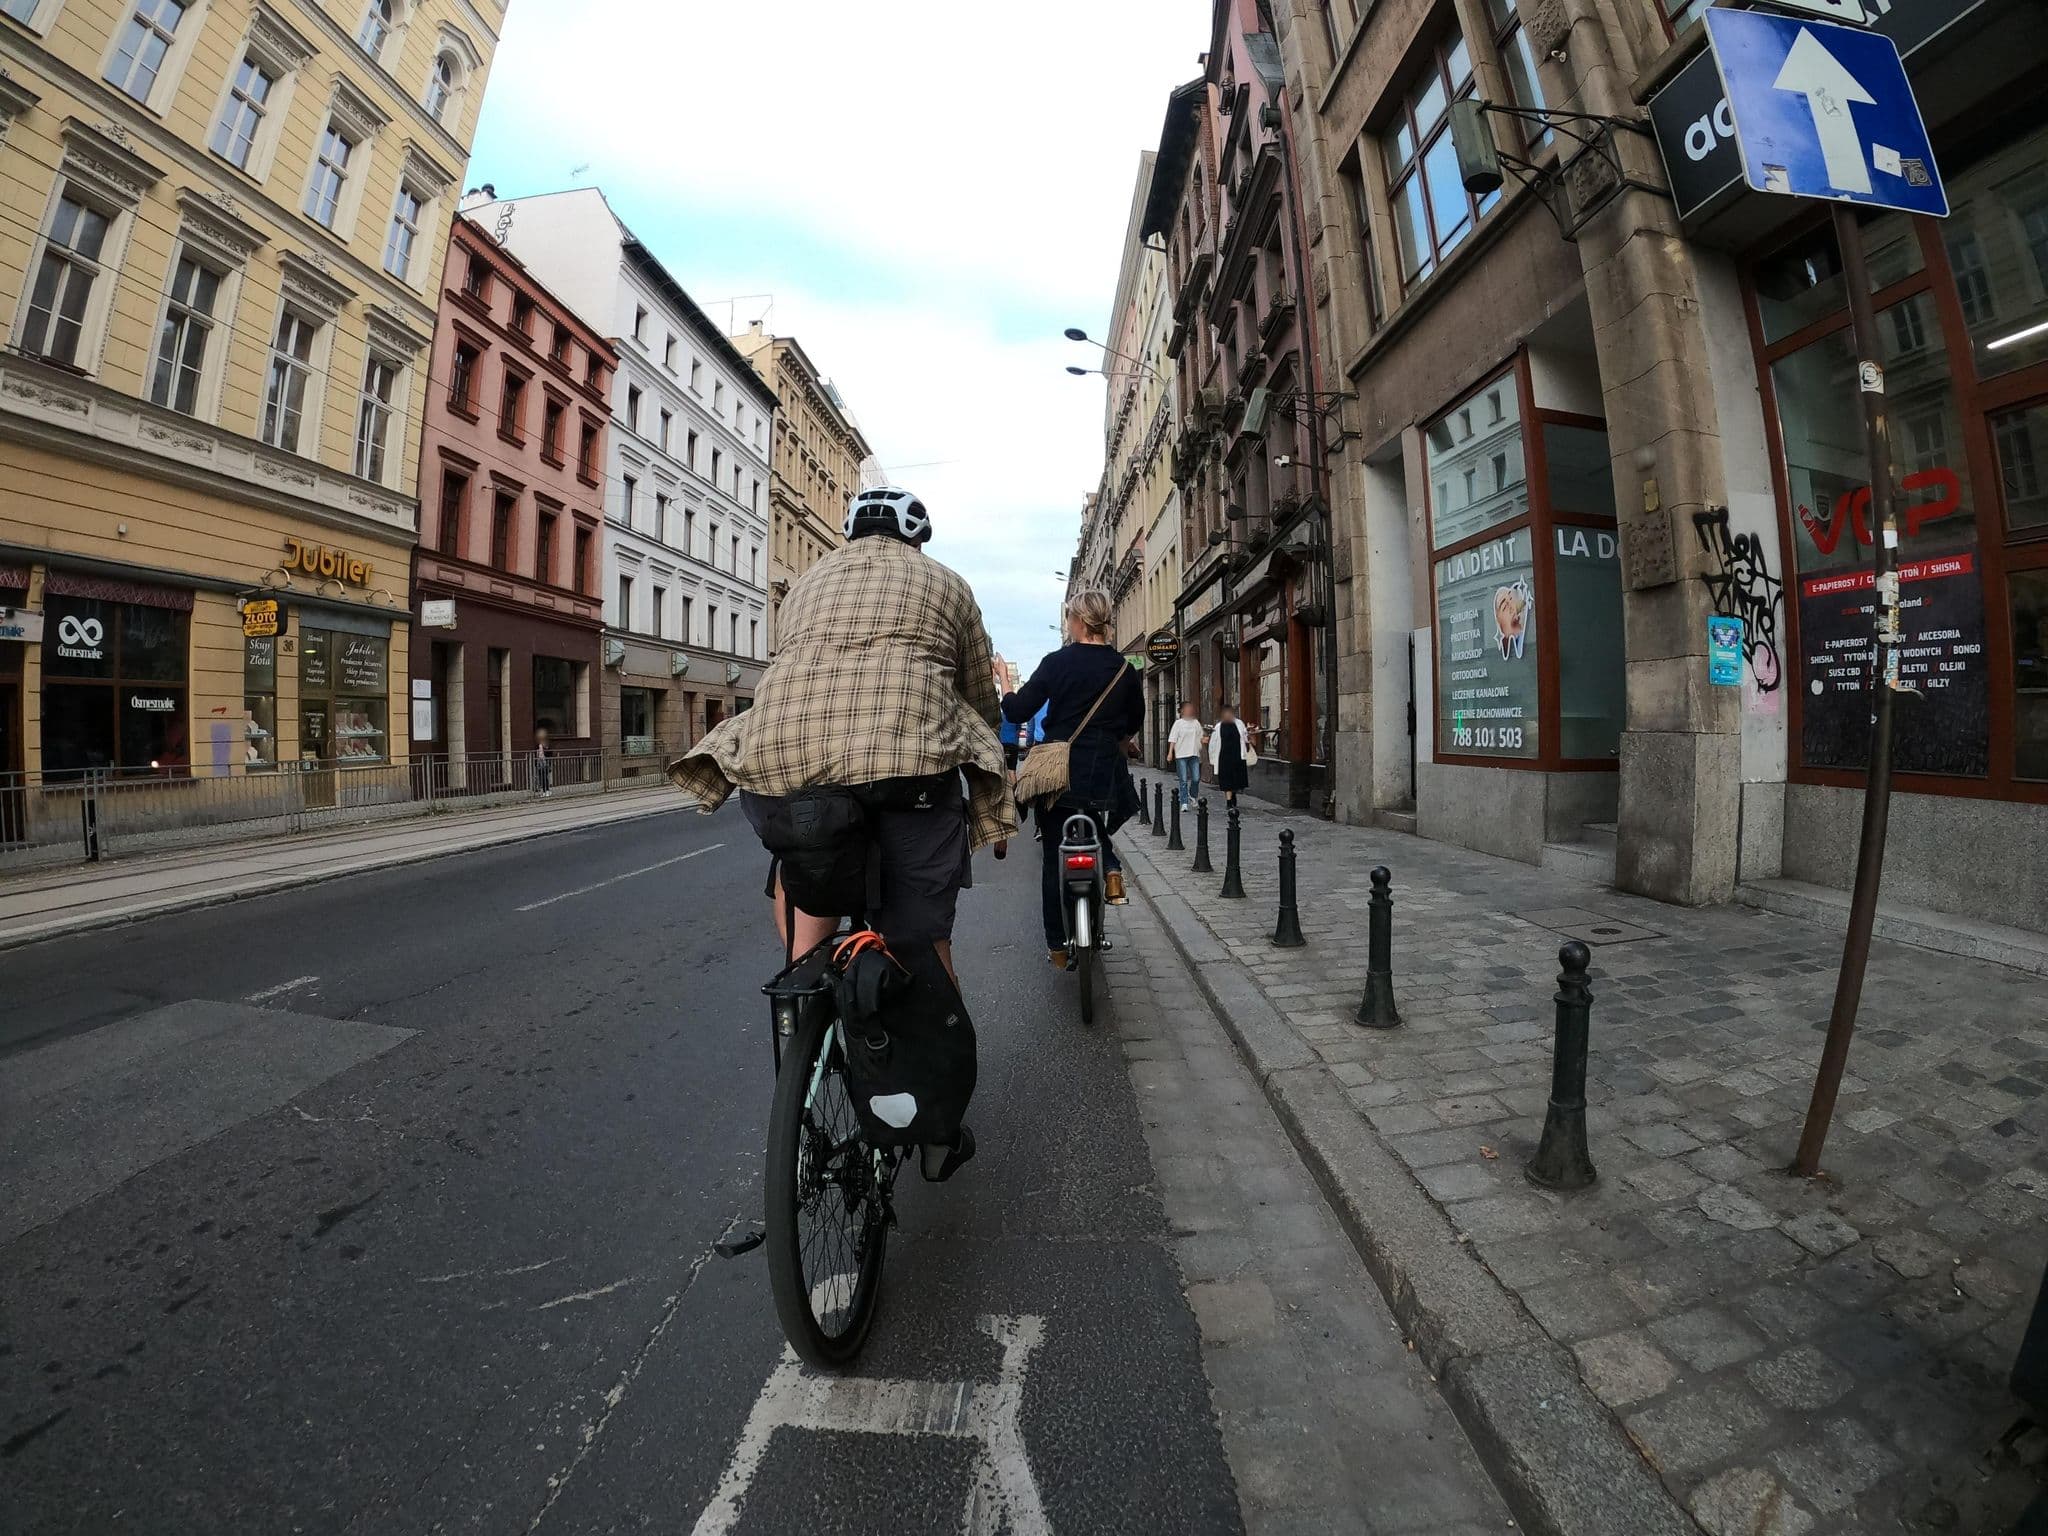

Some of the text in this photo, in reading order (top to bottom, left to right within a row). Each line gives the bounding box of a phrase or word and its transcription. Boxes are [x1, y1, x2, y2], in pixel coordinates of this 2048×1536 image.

[1557, 529, 1590, 557] LA
[280, 536, 373, 585] Jubiler
[1447, 537, 1516, 583] LA DENT
[1812, 578, 1855, 593] E-PAPIEROSY
[1897, 565, 1919, 579] YTOŃ
[1931, 561, 1960, 574] SHISHA
[249, 639, 270, 654] Skup
[1825, 638, 1868, 649] E-PAPIEROSY
[1918, 629, 1961, 641] AKCESORIA
[1810, 655, 1834, 665] SHISHA
[1843, 649, 1867, 662] TYTOŃ
[1903, 647, 1942, 658] WODNYCH
[1953, 644, 1981, 654] BONGO
[1451, 667, 1488, 681] ORTODONCJA
[1828, 668, 1846, 677] SUSZ
[1846, 667, 1861, 676] CBD
[1902, 663, 1928, 673] BLETKI
[1939, 661, 1966, 672] OLEJKI
[1476, 686, 1509, 698] KANAŁOWE
[1927, 678, 1950, 688] GILZY
[1476, 707, 1522, 719] ZACHOWAWCZE
[1452, 727, 1522, 749] 788 101 503
